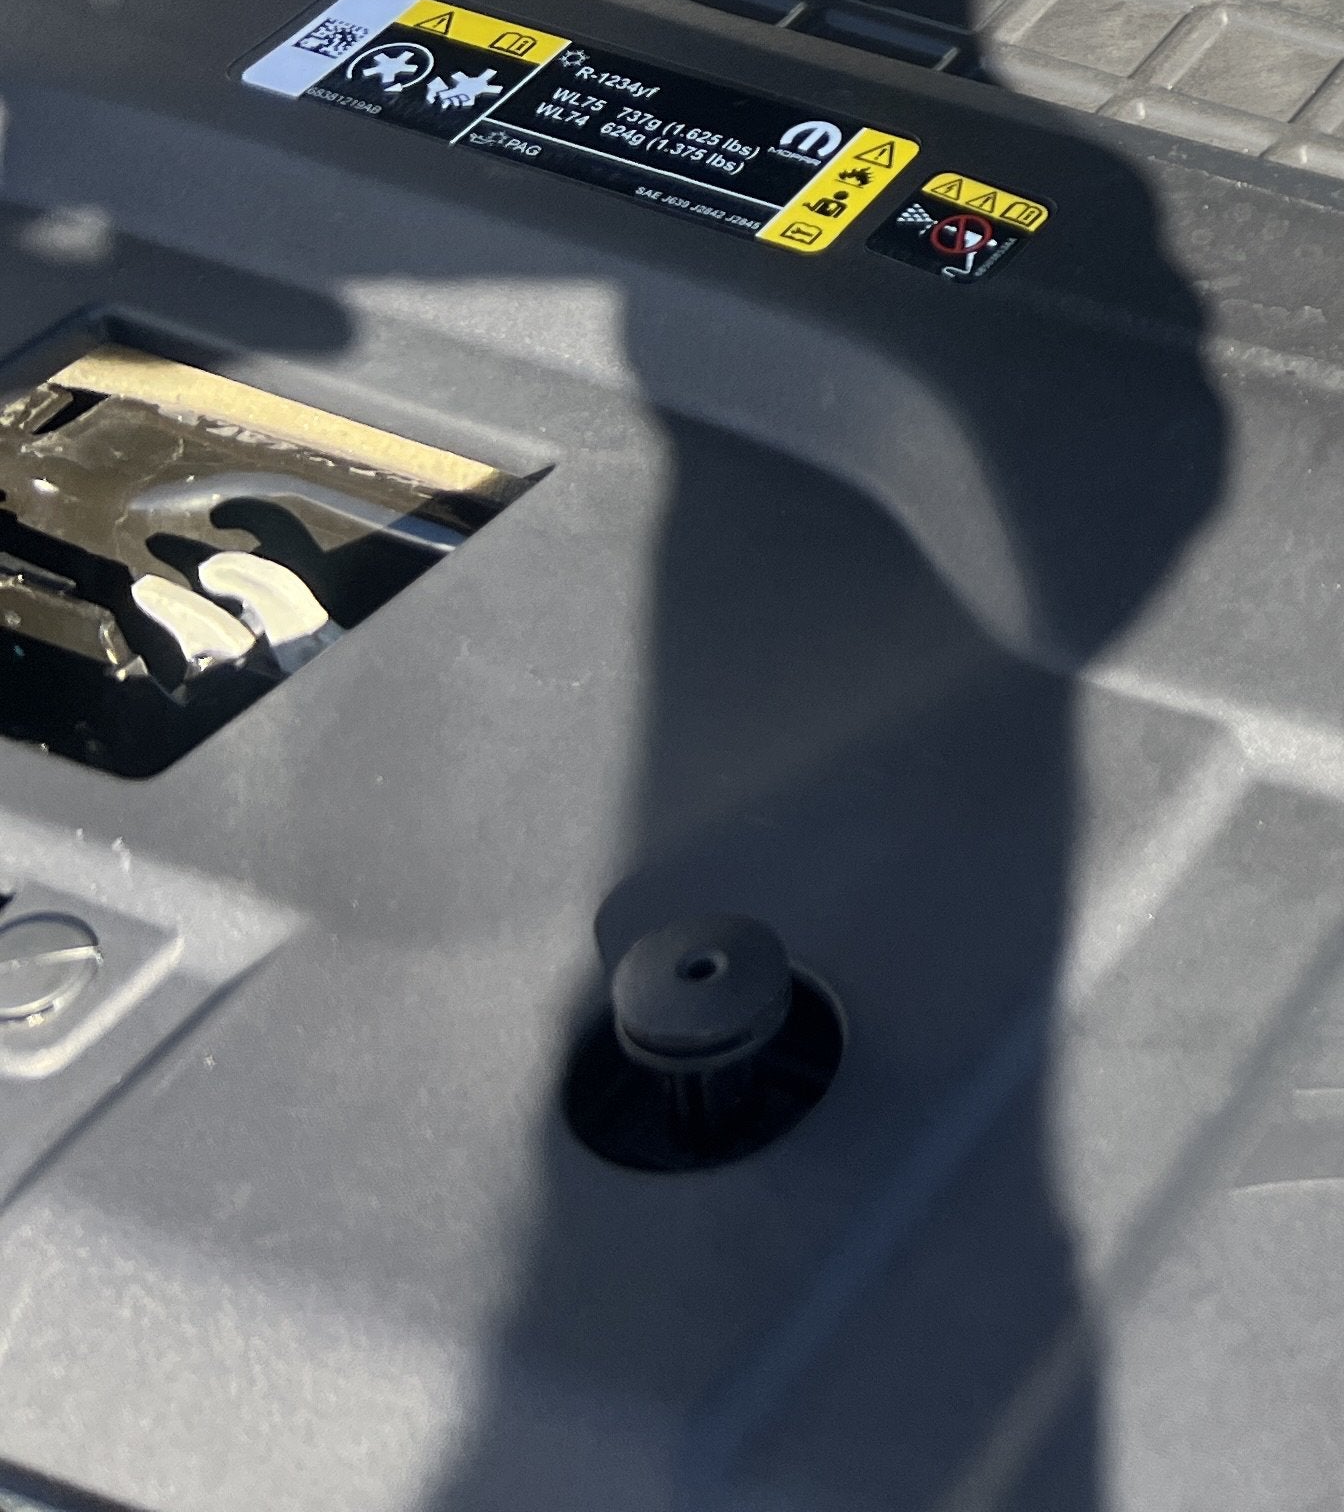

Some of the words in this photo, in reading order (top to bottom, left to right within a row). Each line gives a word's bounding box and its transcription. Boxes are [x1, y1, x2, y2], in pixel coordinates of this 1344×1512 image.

[575, 66, 661, 98] R-1234yf
[535, 102, 590, 127] WL74
[600, 122, 646, 147] 624g
[646, 137, 707, 162] (1.375
[705, 153, 745, 176] lbs)
[552, 87, 608, 112] WL75
[616, 107, 663, 131] 737g
[662, 121, 723, 147] (1.625
[722, 137, 761, 160] lbs)
[504, 138, 542, 156] PAG
[635, 187, 662, 201] SAE
